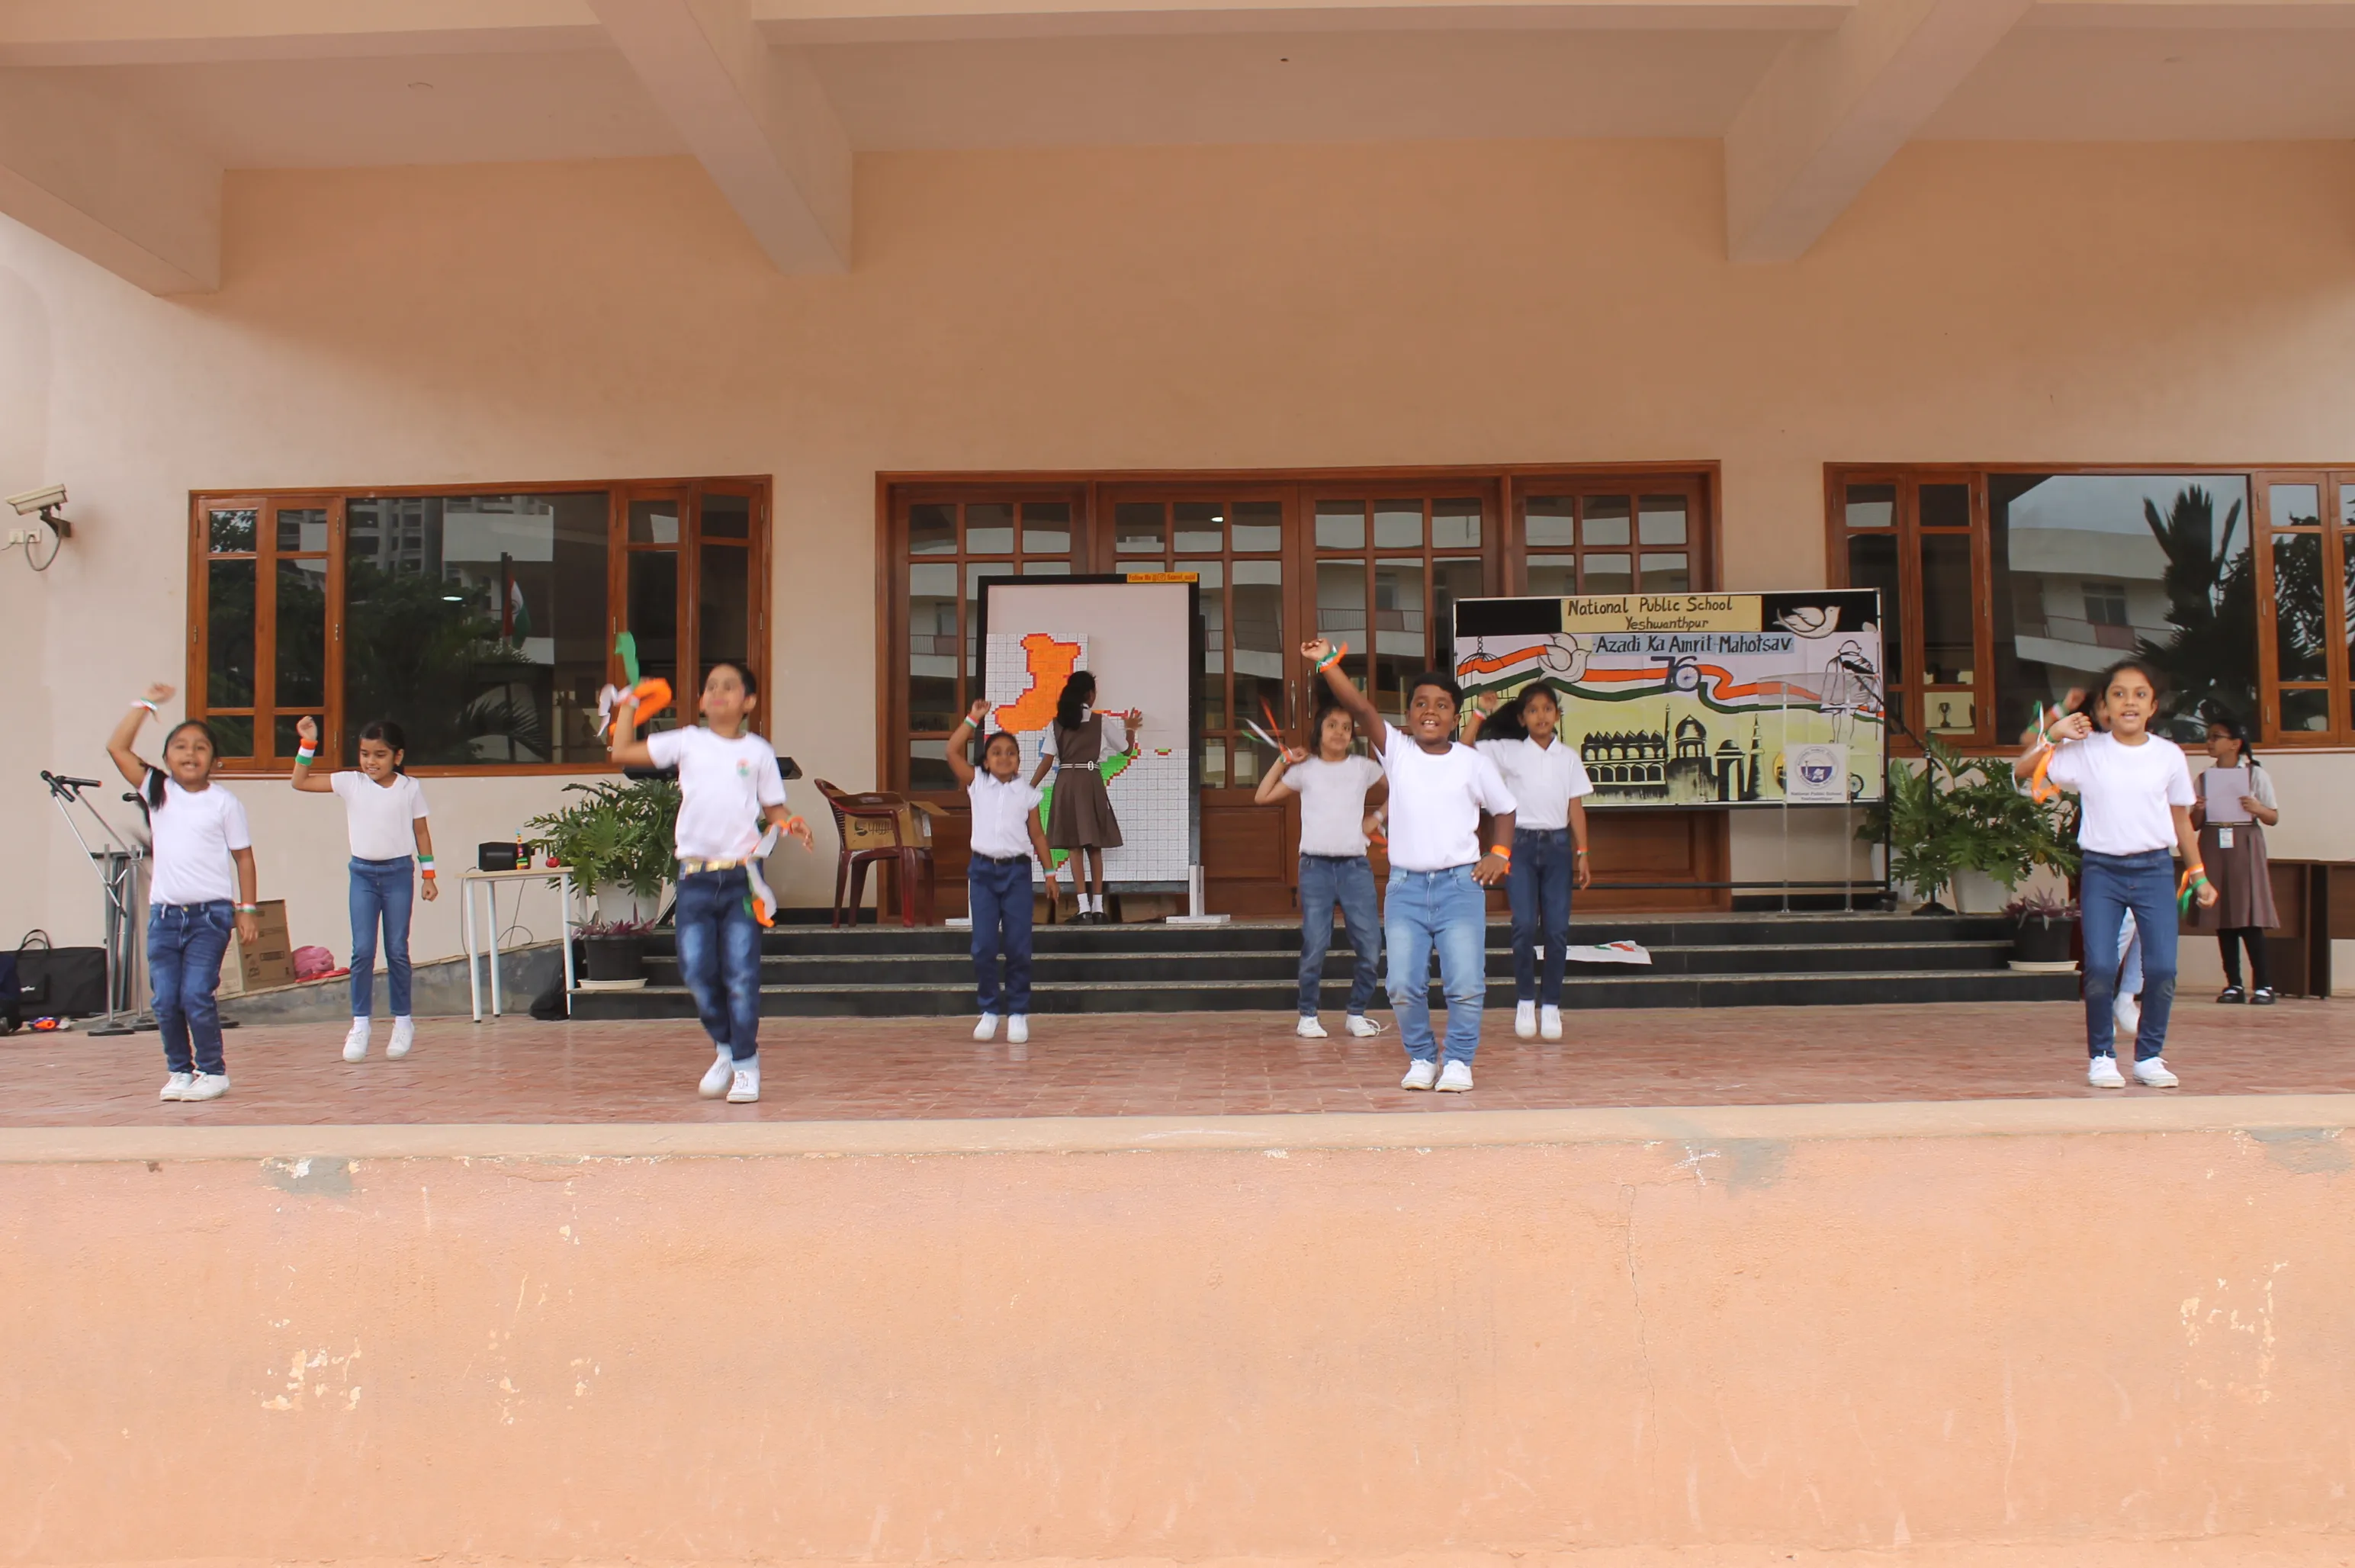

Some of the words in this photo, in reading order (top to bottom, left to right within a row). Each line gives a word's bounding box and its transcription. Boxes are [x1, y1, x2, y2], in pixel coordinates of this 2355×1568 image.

[1567, 598, 1629, 616] National
[1640, 596, 1680, 613] Public
[1685, 596, 1733, 612] School
[1625, 615, 1709, 631] Yeshwanthpur
[1595, 635, 1640, 654] Azadi
[1647, 635, 1665, 653] Ka
[1668, 635, 1712, 654] Amrit
[1718, 634, 1792, 654] Mahotsav
